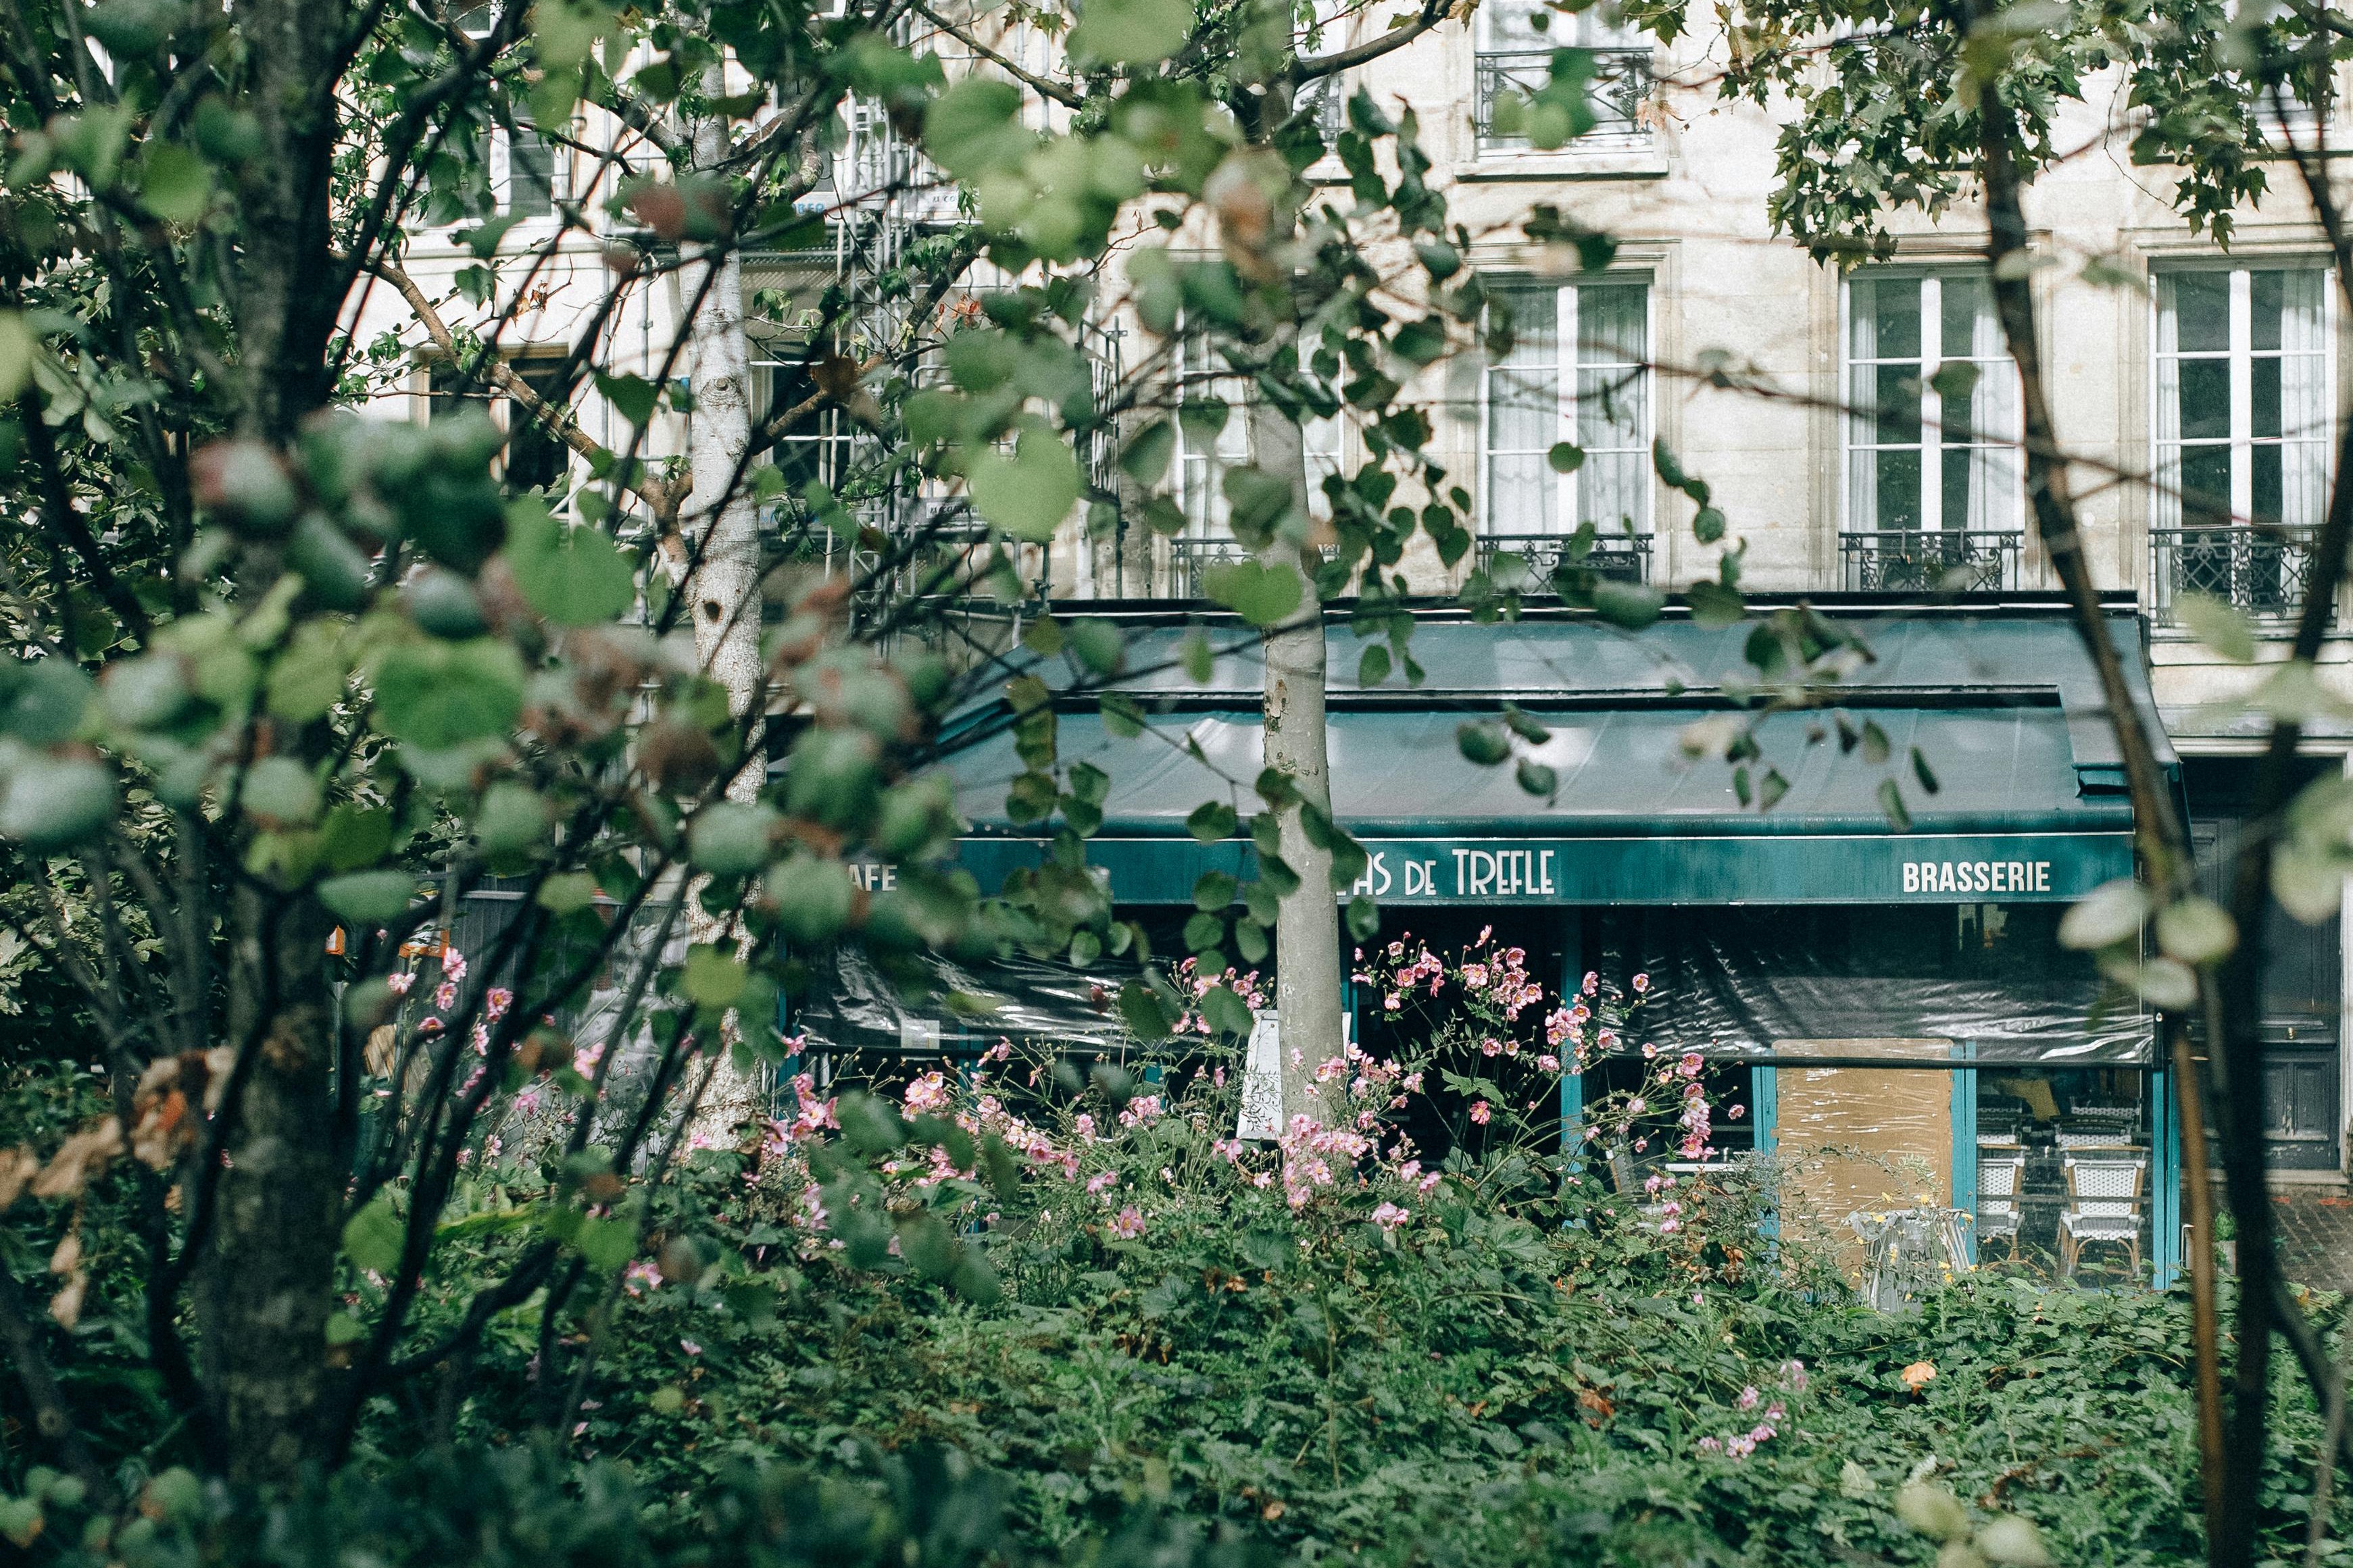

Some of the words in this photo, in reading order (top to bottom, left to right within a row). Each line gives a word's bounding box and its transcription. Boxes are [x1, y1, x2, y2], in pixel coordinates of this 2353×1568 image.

[848, 864, 897, 891] AFE
[1336, 851, 1392, 896] AS
[1405, 860, 1437, 896] DE
[1452, 849, 1555, 895] TREFLE
[1903, 861, 2050, 892] BRASSERIE
